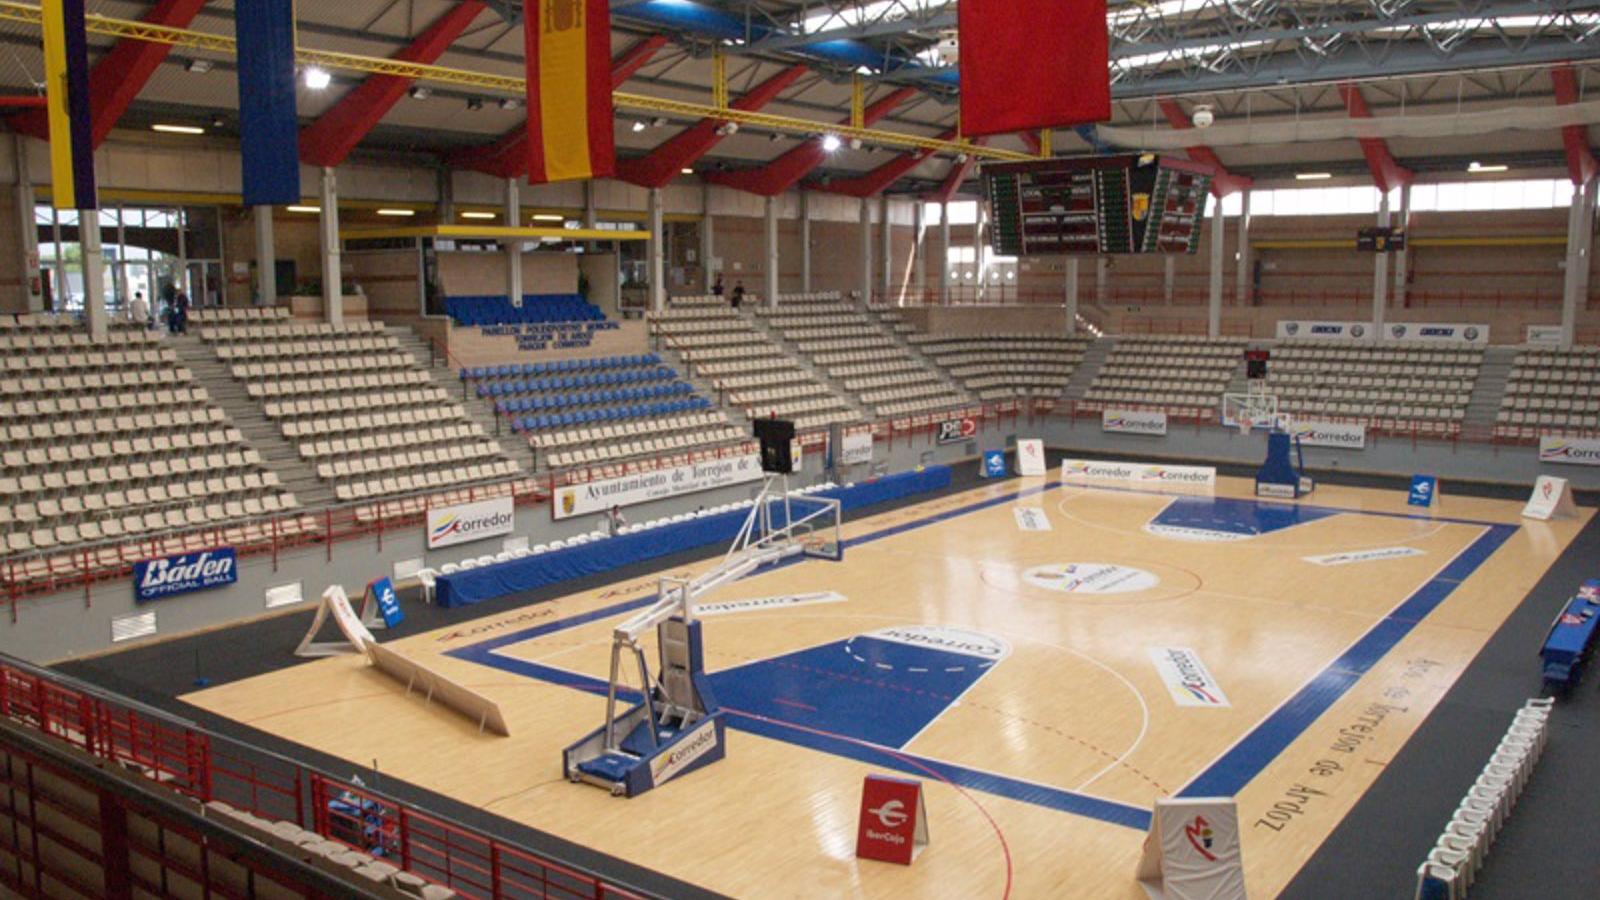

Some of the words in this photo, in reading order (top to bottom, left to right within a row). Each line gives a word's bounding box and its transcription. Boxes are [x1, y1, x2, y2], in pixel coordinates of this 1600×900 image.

[1120, 418, 1165, 430] Corredor
[1311, 431, 1362, 442] Corredor
[585, 474, 667, 501] Ayuntamiento
[671, 469, 685, 482] de
[737, 459, 748, 471] de
[1084, 466, 1131, 478] Corredor
[1160, 470, 1209, 482] Corredor
[453, 512, 513, 533] Corredor
[141, 552, 234, 589] Báden
[141, 581, 201, 597] OFFICIAL
[203, 574, 235, 587] BALL
[880, 629, 1001, 656] Corredor
[670, 730, 714, 766] Corredor
[1308, 759, 1344, 777] de
[1253, 782, 1329, 832] Ardoz
